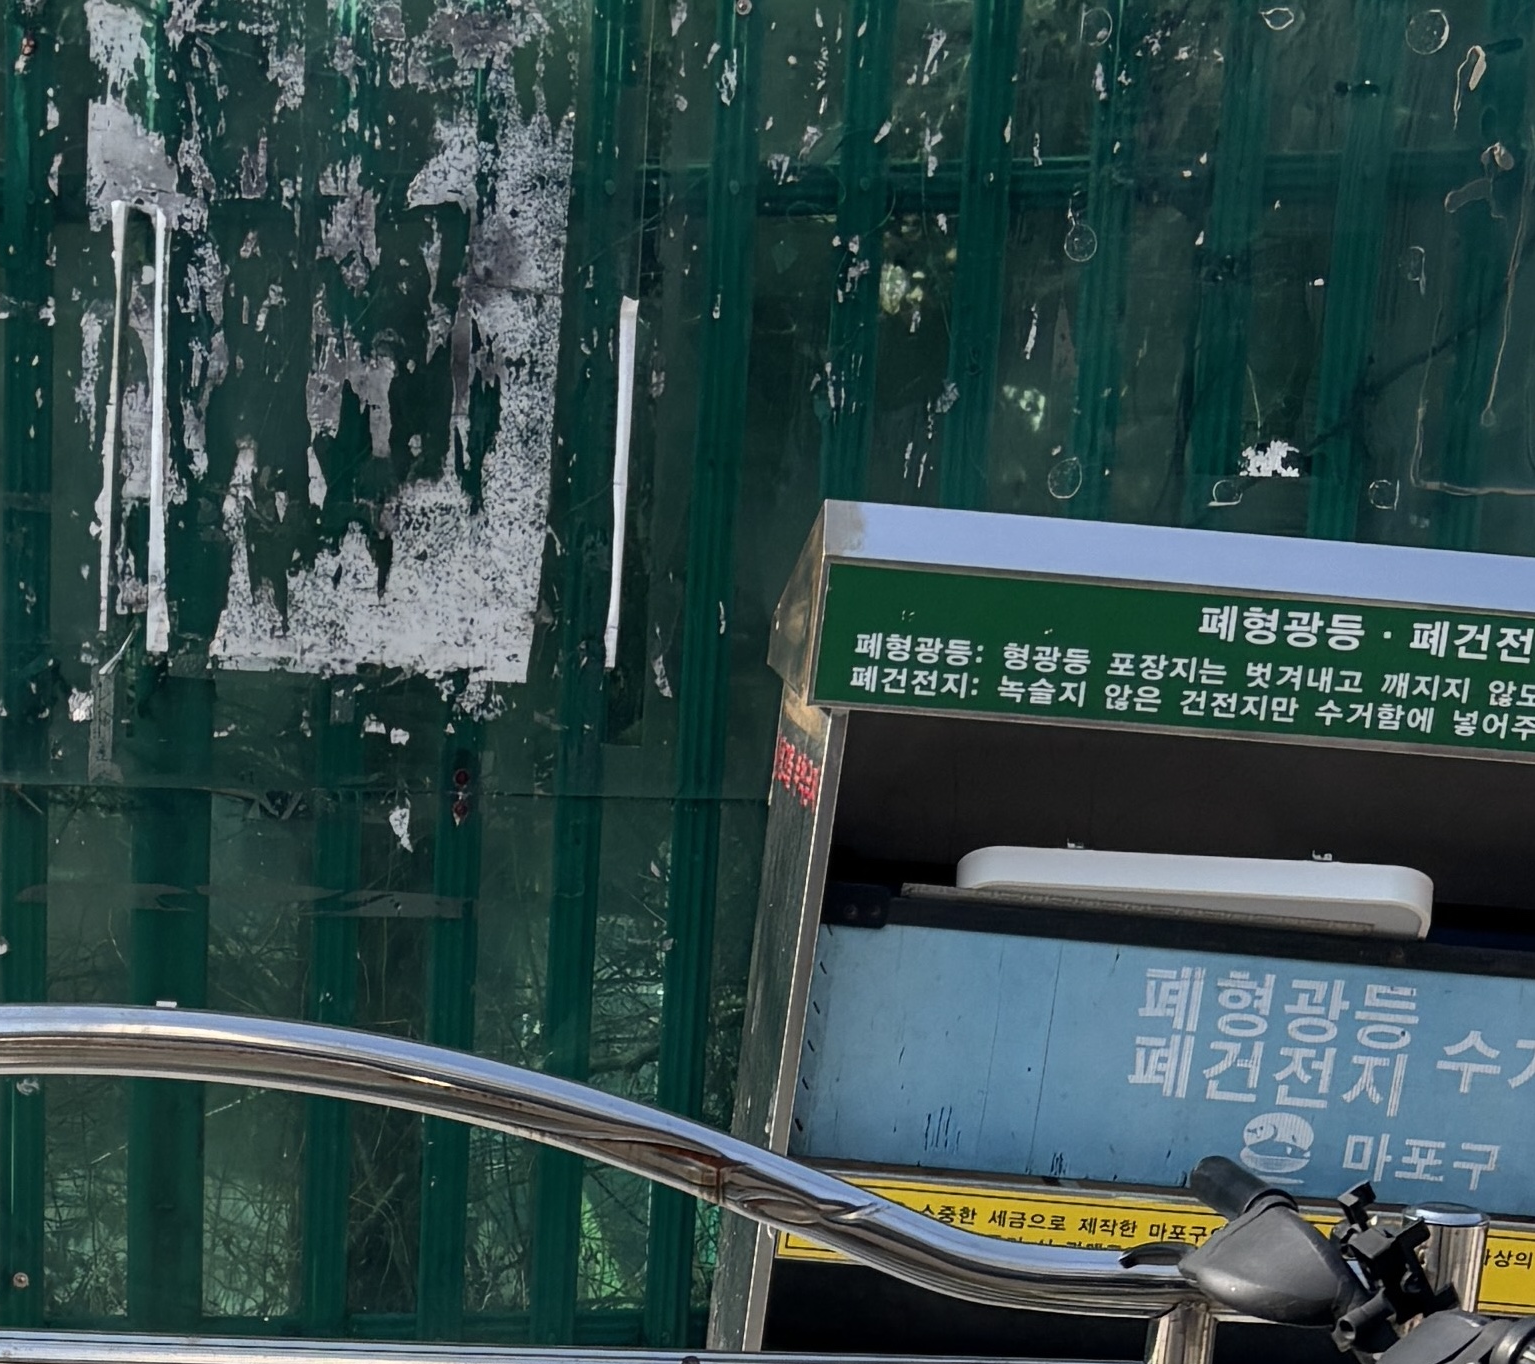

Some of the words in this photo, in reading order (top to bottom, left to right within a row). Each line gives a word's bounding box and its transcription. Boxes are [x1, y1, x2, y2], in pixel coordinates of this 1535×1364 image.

[854, 632, 984, 667] 폐형광등:
[1003, 642, 1092, 675] 형광등
[1106, 652, 1227, 685] 포장지는
[1245, 661, 1363, 694] 벗겨내고
[1380, 672, 1471, 704] 깨지지
[1198, 605, 1365, 651] 폐형광등
[1409, 620, 1535, 664] 폐건전
[850, 665, 980, 699] 폐건전지:
[997, 675, 1087, 708] 녹슬지
[1104, 683, 1162, 713] 않은
[1180, 690, 1299, 723] 건전지만
[1315, 699, 1435, 734] 수거함에
[1453, 709, 1535, 741] 넣어주
[1138, 966, 1419, 1051] 폐형광등
[1127, 1034, 1408, 1117] 폐건전지
[1342, 1132, 1502, 1191] 마포구
[988, 1209, 1067, 1232] 세금으로
[1078, 1217, 1138, 1238] 제작한
[1149, 1222, 1224, 1246] 마포구
[1483, 1248, 1533, 1270] 상의
